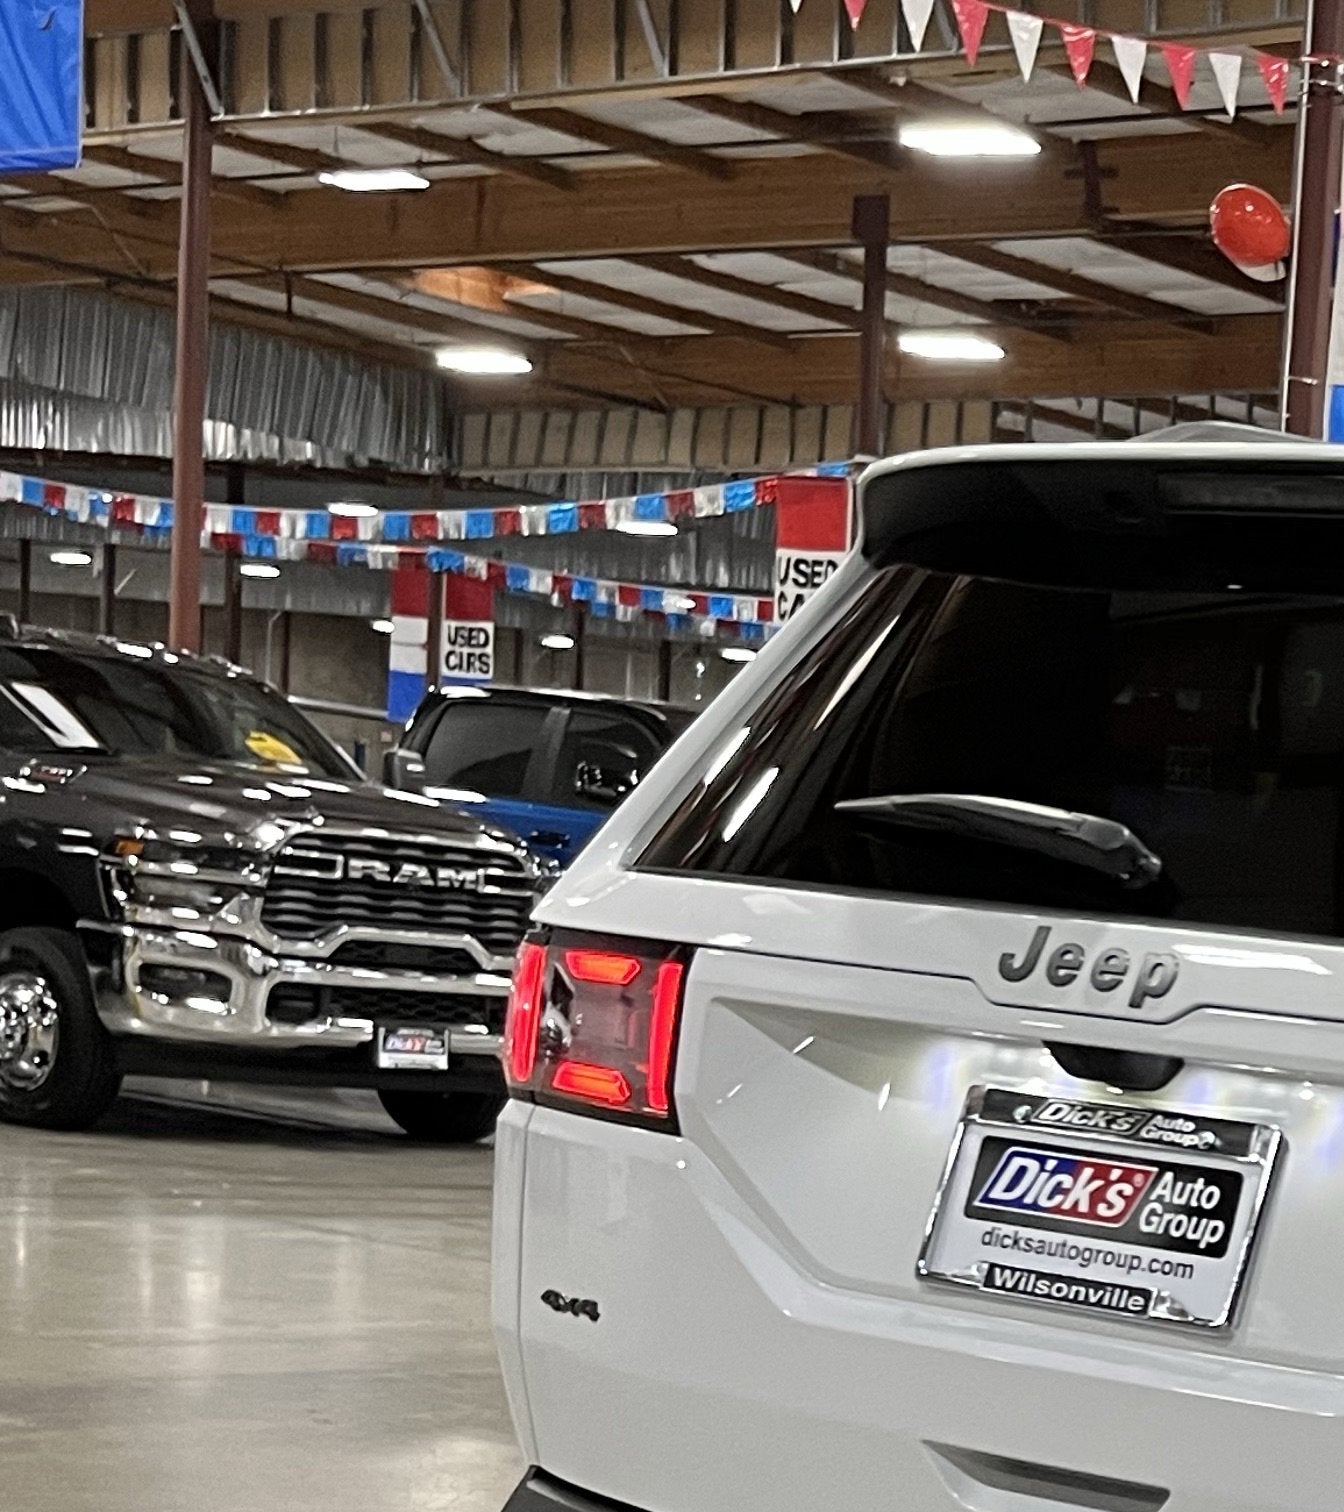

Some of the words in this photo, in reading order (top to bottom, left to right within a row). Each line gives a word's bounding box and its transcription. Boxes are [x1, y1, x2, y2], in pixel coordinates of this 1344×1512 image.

[448, 625, 490, 648] USED
[348, 859, 478, 889] RAM
[998, 925, 1180, 1009] Jeep
[1140, 1125, 1201, 1147] Group
[1152, 1115, 1197, 1132] Auto
[1150, 1171, 1222, 1210] Auto
[1139, 1203, 1226, 1249] Group
[981, 1227, 1195, 1280] dicksautogroup.com
[993, 1266, 1146, 1311] Wilsonville
